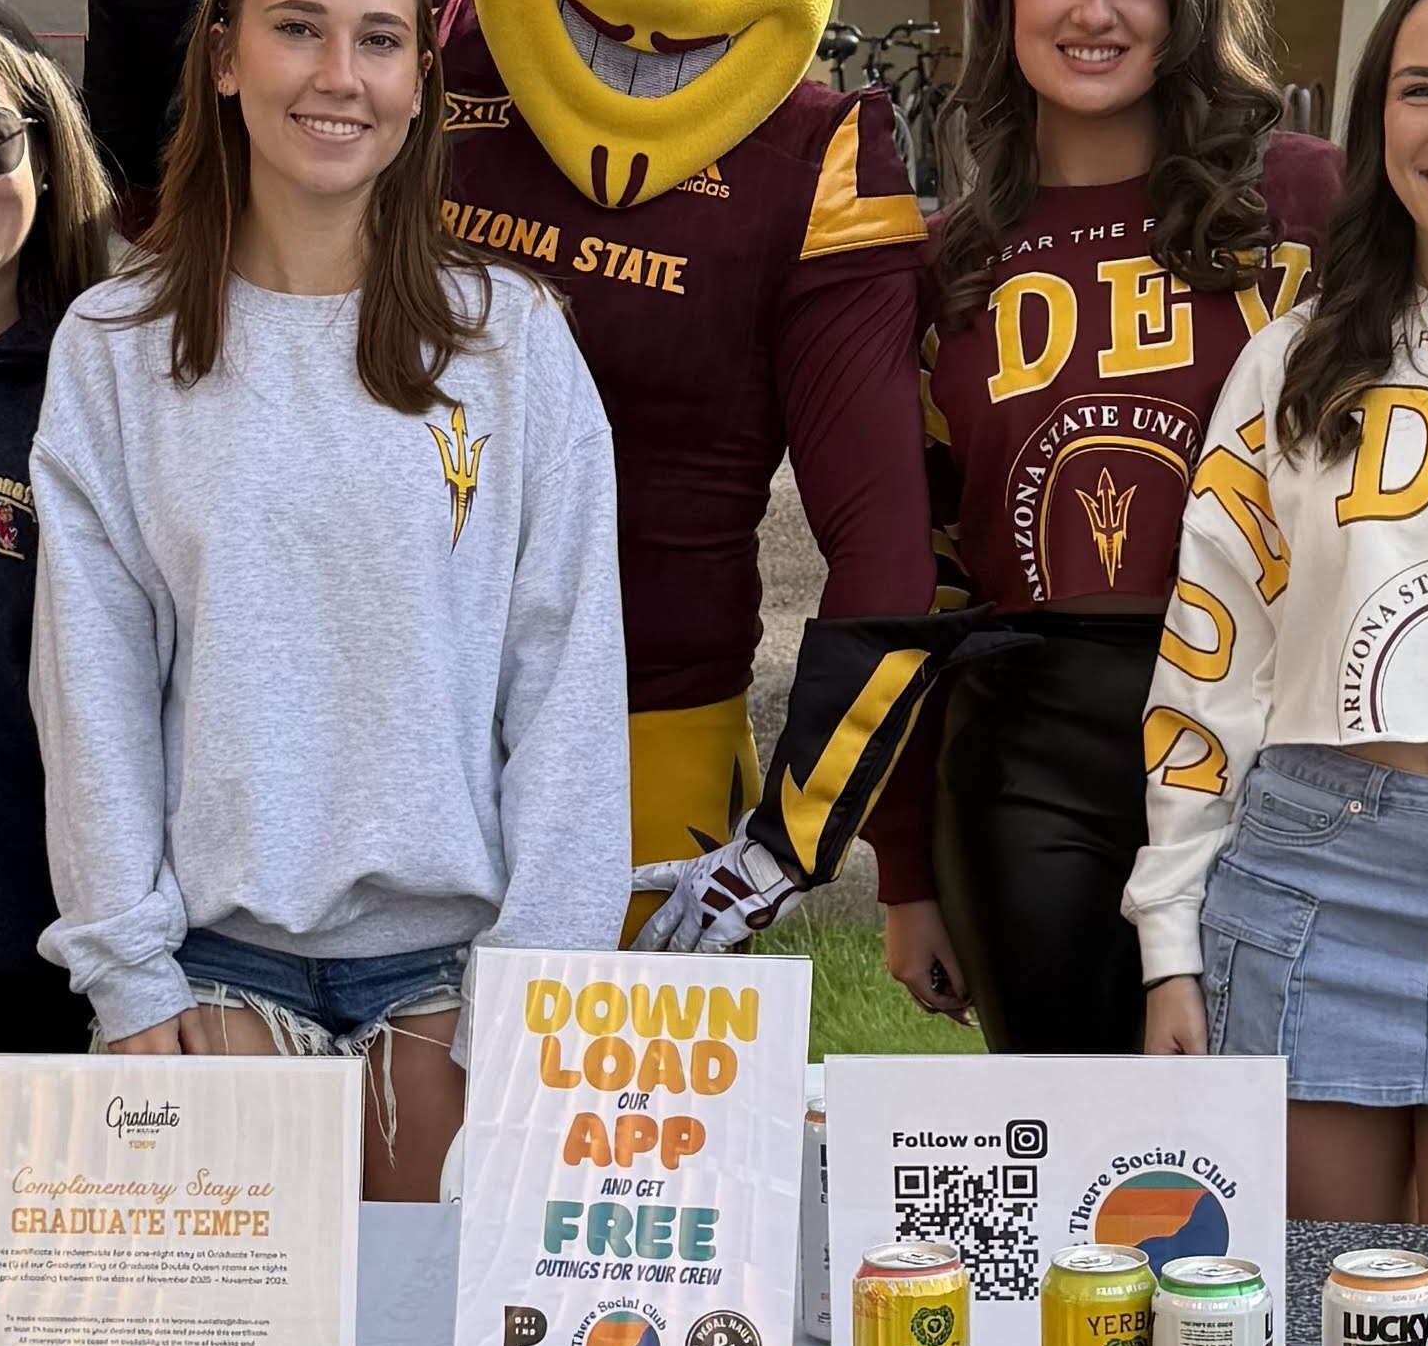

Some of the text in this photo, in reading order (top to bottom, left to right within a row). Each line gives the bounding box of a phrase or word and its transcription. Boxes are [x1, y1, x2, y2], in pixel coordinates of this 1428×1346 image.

[675, 177, 730, 198] didas
[441, 200, 688, 295] RIZONA STATE
[1070, 222, 1125, 244] THE
[1039, 405, 1119, 459] STATE
[1344, 604, 1396, 734] ARIZONA
[525, 980, 759, 1042] DOWN
[540, 1035, 738, 1095] LOAD
[106, 1096, 180, 1139] Graduate
[618, 1092, 650, 1110] OUR
[563, 1112, 707, 1170] APP
[892, 1131, 1002, 1149] Follow on
[11, 1166, 275, 1205] Complimentary Stay at
[600, 1178, 665, 1198] AND GET
[1069, 1147, 1238, 1234] There Social Club
[11, 1207, 270, 1237] GRADUATE TEMPE
[543, 1201, 720, 1262] FREE
[535, 1258, 723, 1286] OUTINGS FOR YOUR CREW
[572, 1310, 597, 1346] There
[597, 1296, 641, 1313] Social
[642, 1303, 667, 1331] Club
